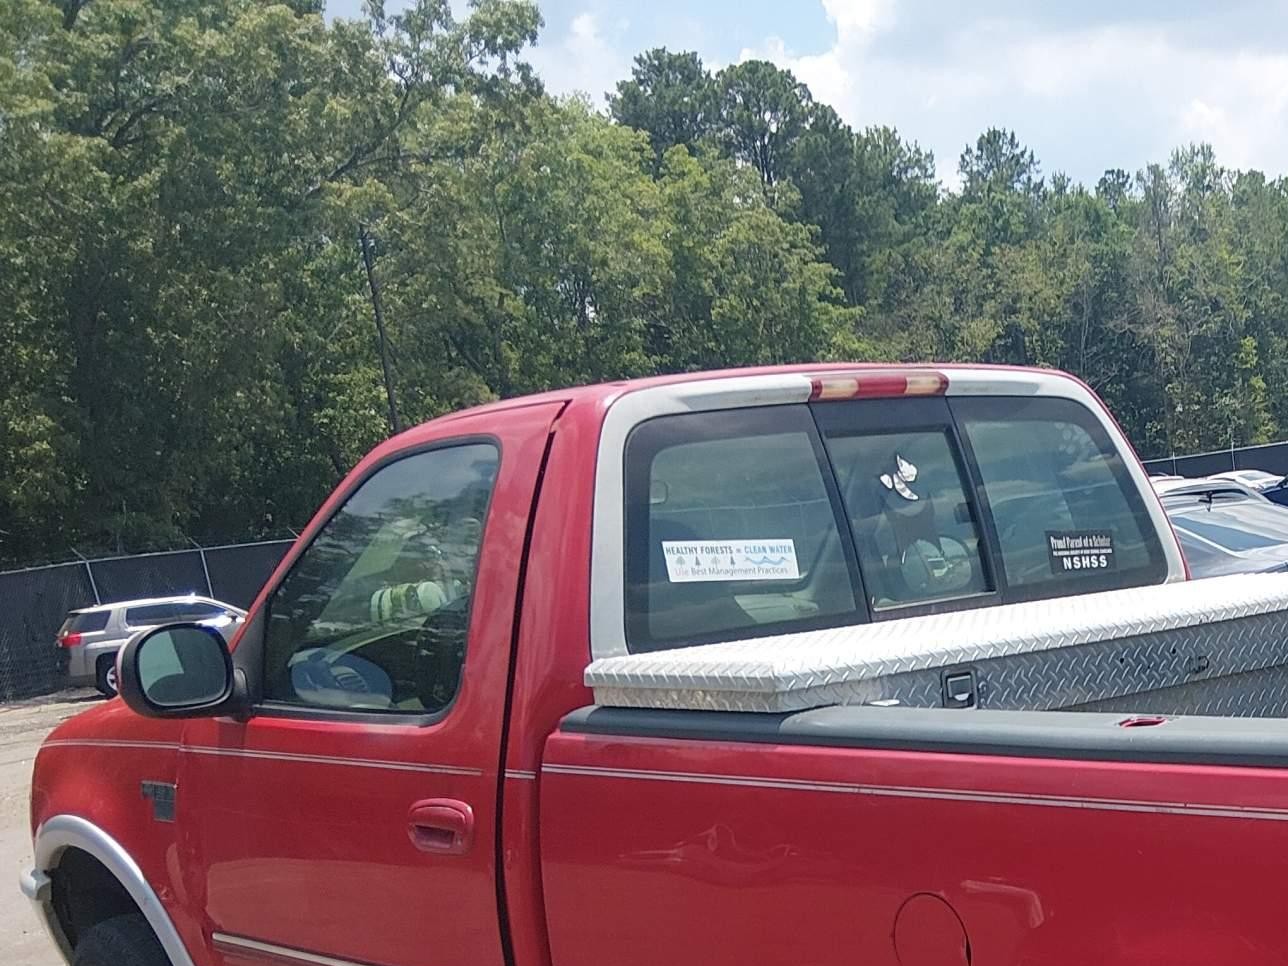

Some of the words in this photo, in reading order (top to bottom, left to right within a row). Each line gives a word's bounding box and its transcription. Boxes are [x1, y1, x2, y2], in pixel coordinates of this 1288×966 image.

[665, 546, 698, 555] HEALTHY
[701, 545, 733, 555] FORESTS
[744, 545, 766, 554] CLEAN
[769, 545, 792, 553] WATER
[1063, 555, 1108, 569] NSHSS
[675, 568, 689, 576] Use
[691, 567, 707, 576] Best
[708, 567, 756, 577] Management
